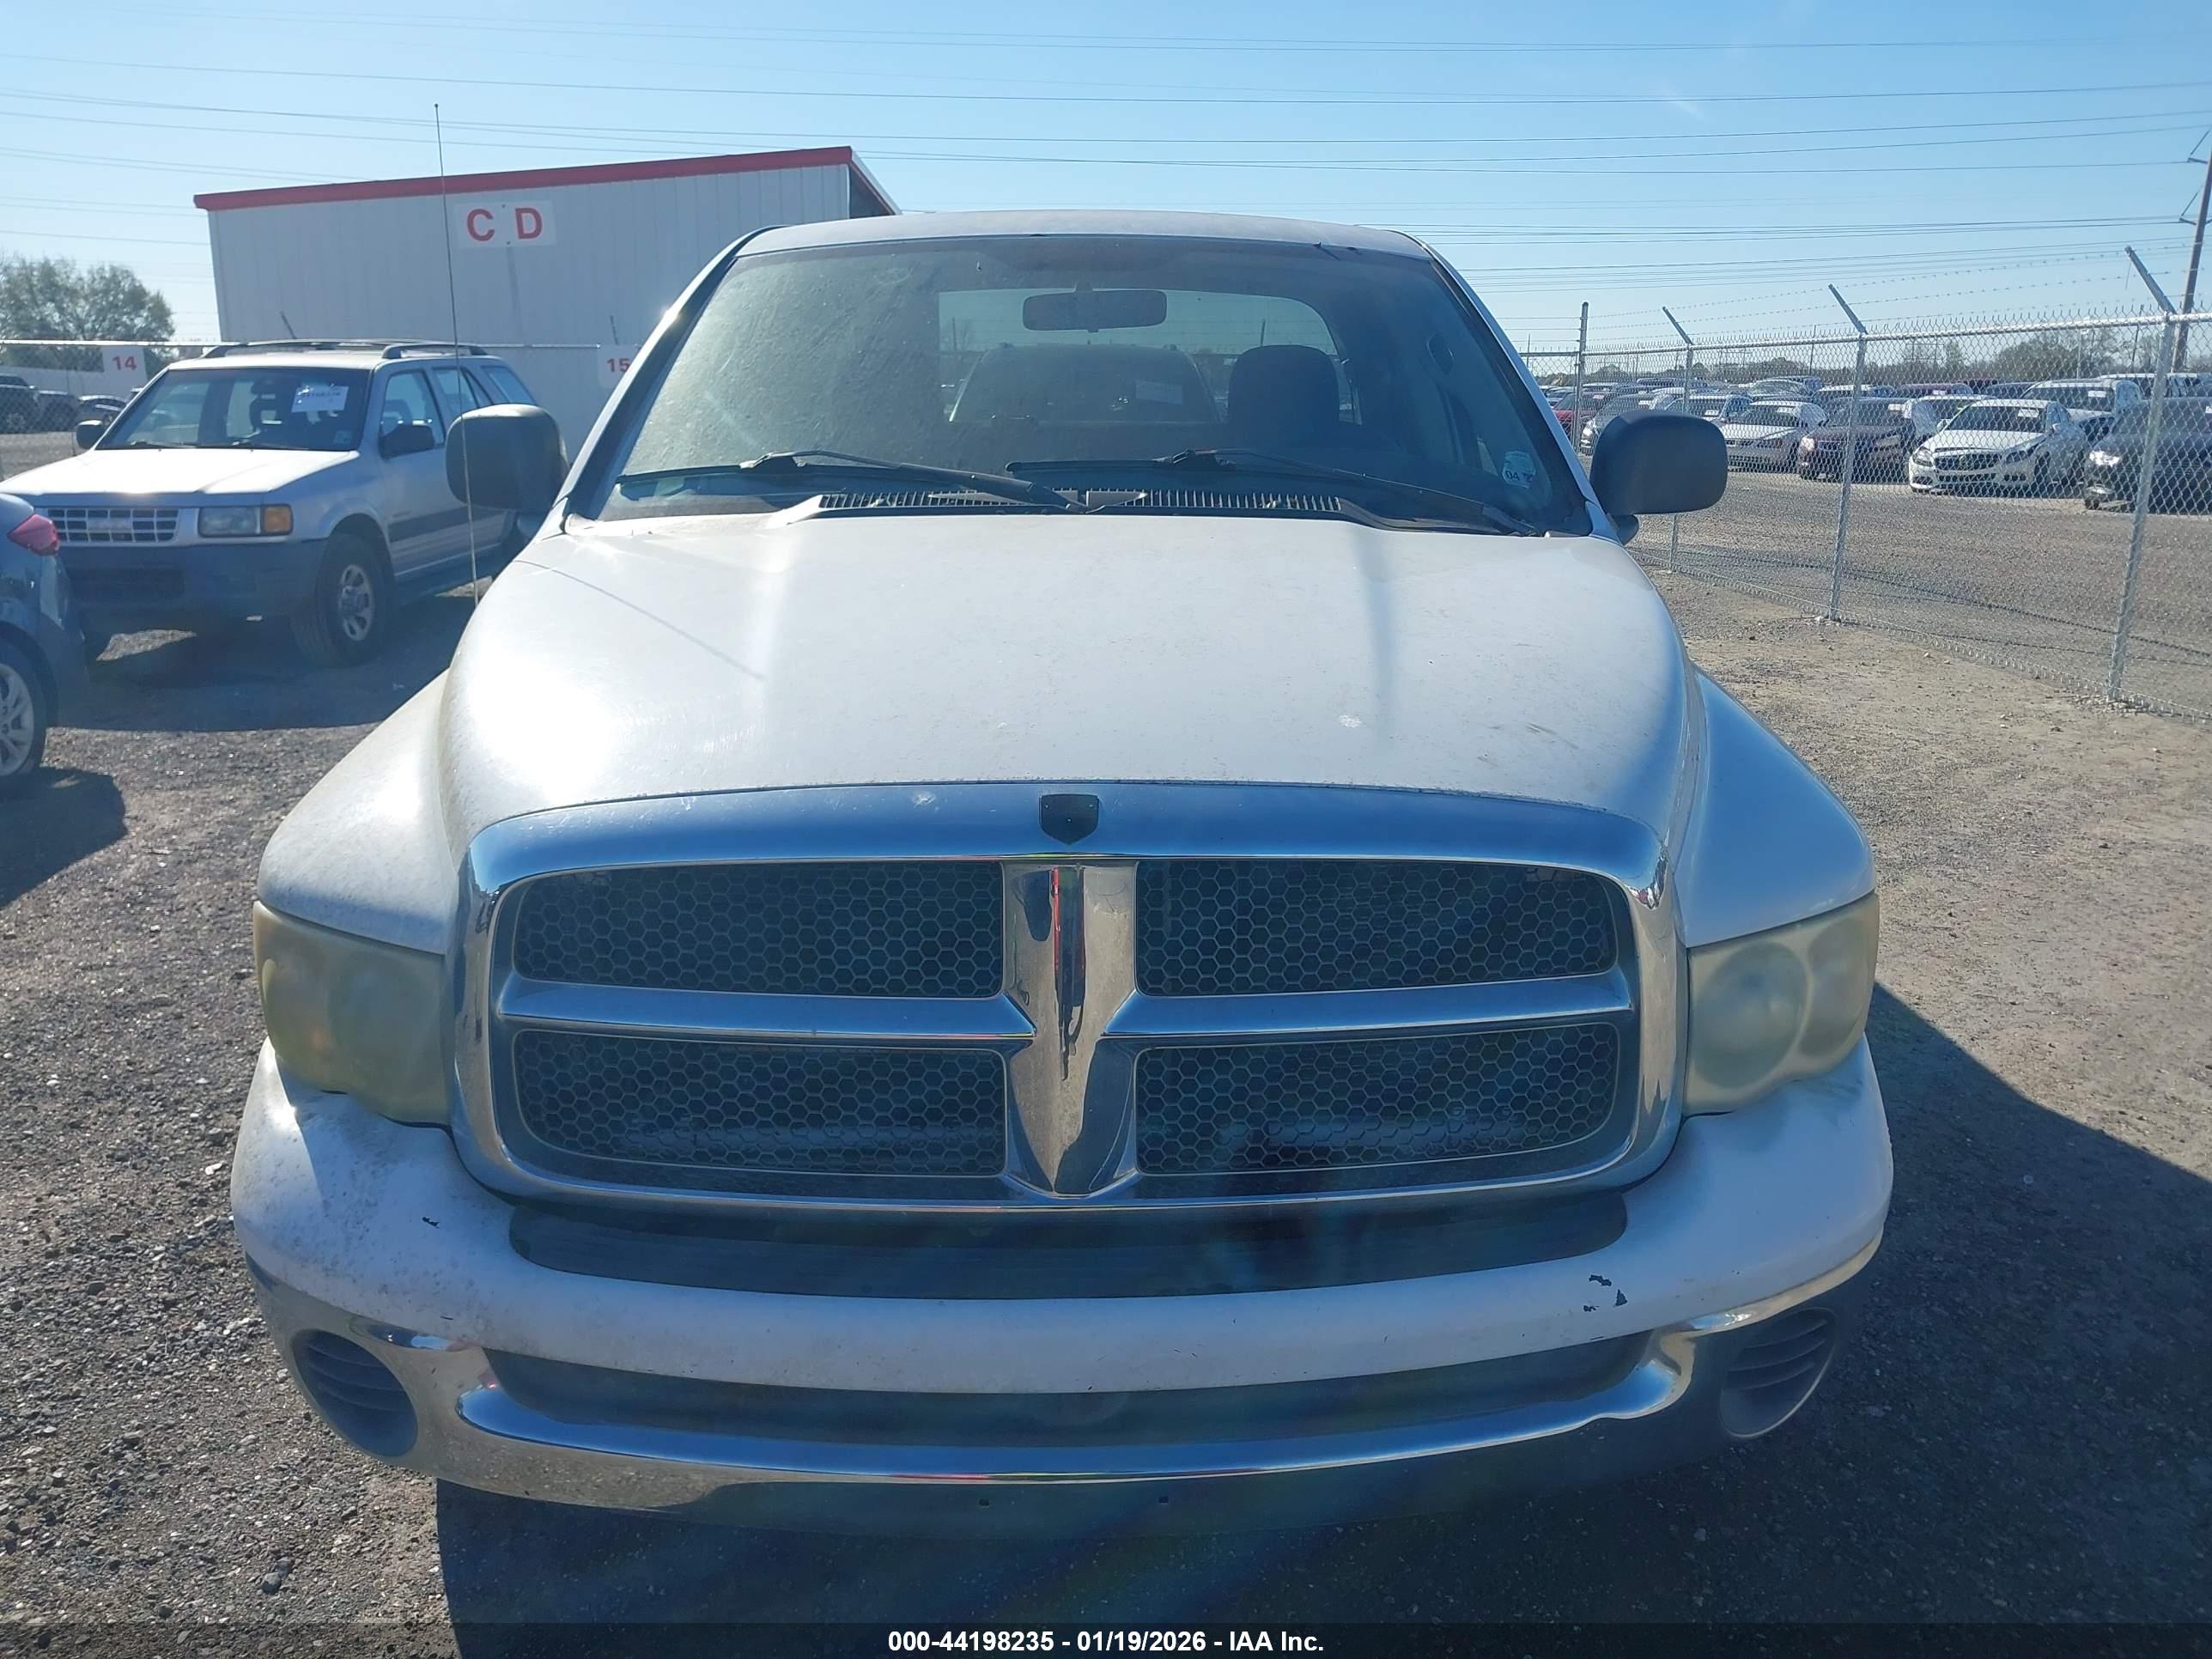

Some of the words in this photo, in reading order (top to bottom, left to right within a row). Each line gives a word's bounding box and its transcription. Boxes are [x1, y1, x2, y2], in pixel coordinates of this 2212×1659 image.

[467, 208, 495, 242] C
[515, 207, 543, 240] D
[112, 356, 137, 370] 14
[607, 357, 630, 372] 15
